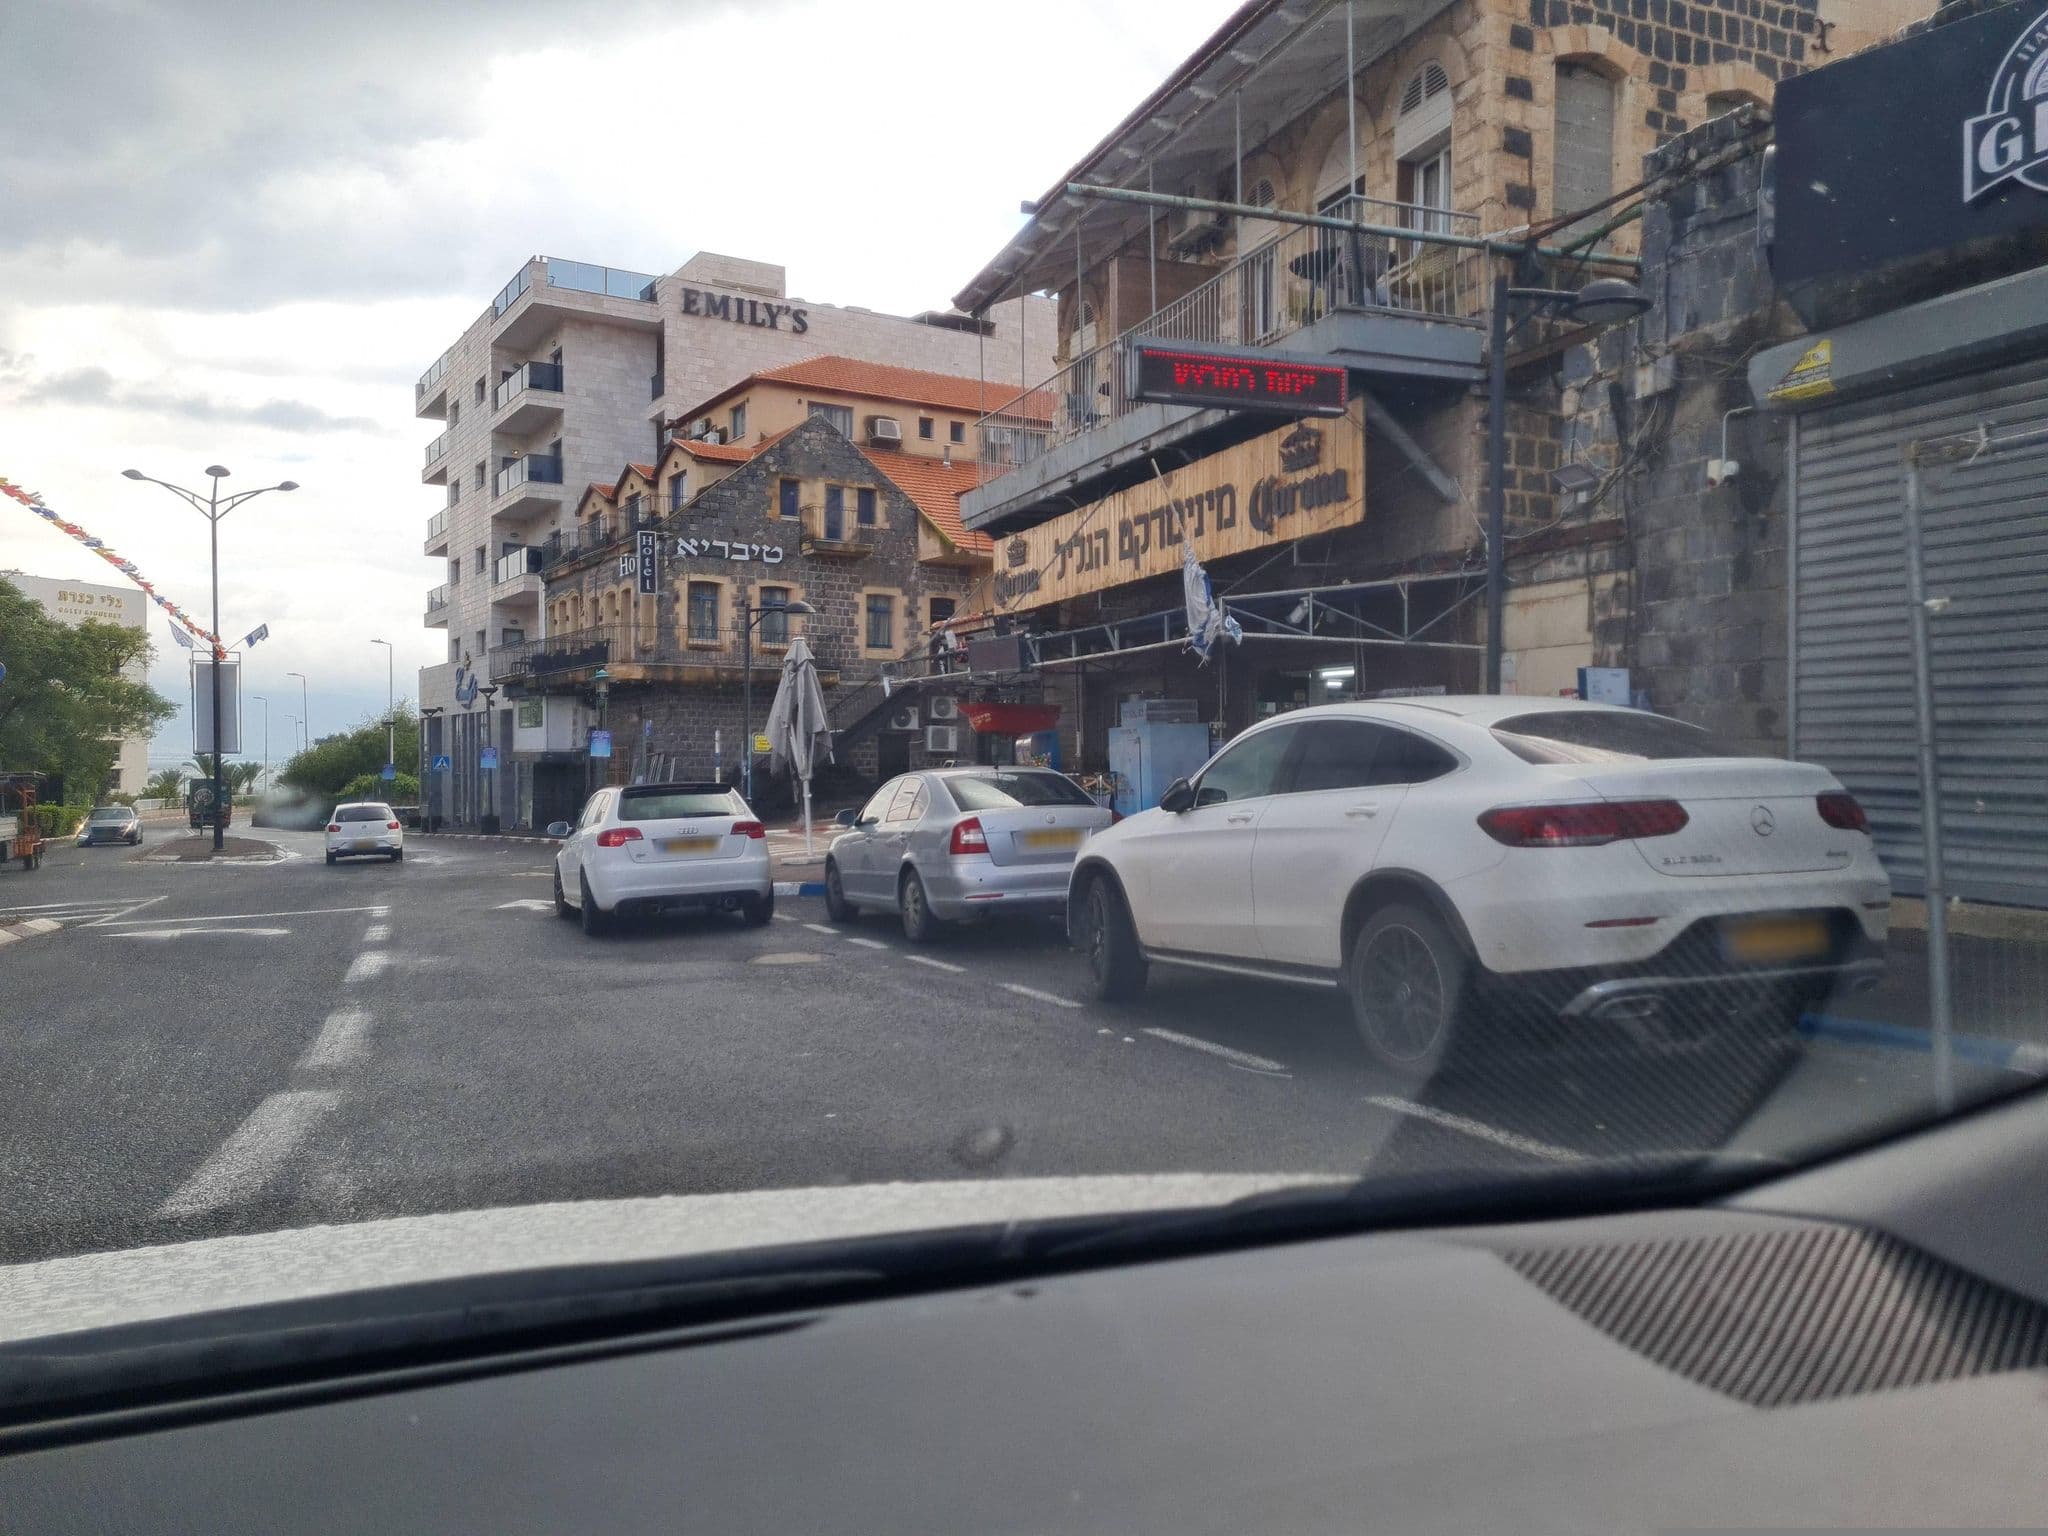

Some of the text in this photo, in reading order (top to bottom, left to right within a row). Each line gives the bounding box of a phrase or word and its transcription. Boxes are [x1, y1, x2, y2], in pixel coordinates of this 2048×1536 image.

[2017, 24, 2048, 62] ITA
[681, 287, 808, 333] EMILY'S
[641, 534, 653, 591] Hotel
[676, 537, 783, 563] טיבריא
[1054, 527, 1108, 581] הגליל
[57, 590, 123, 608] גלי כנרת
